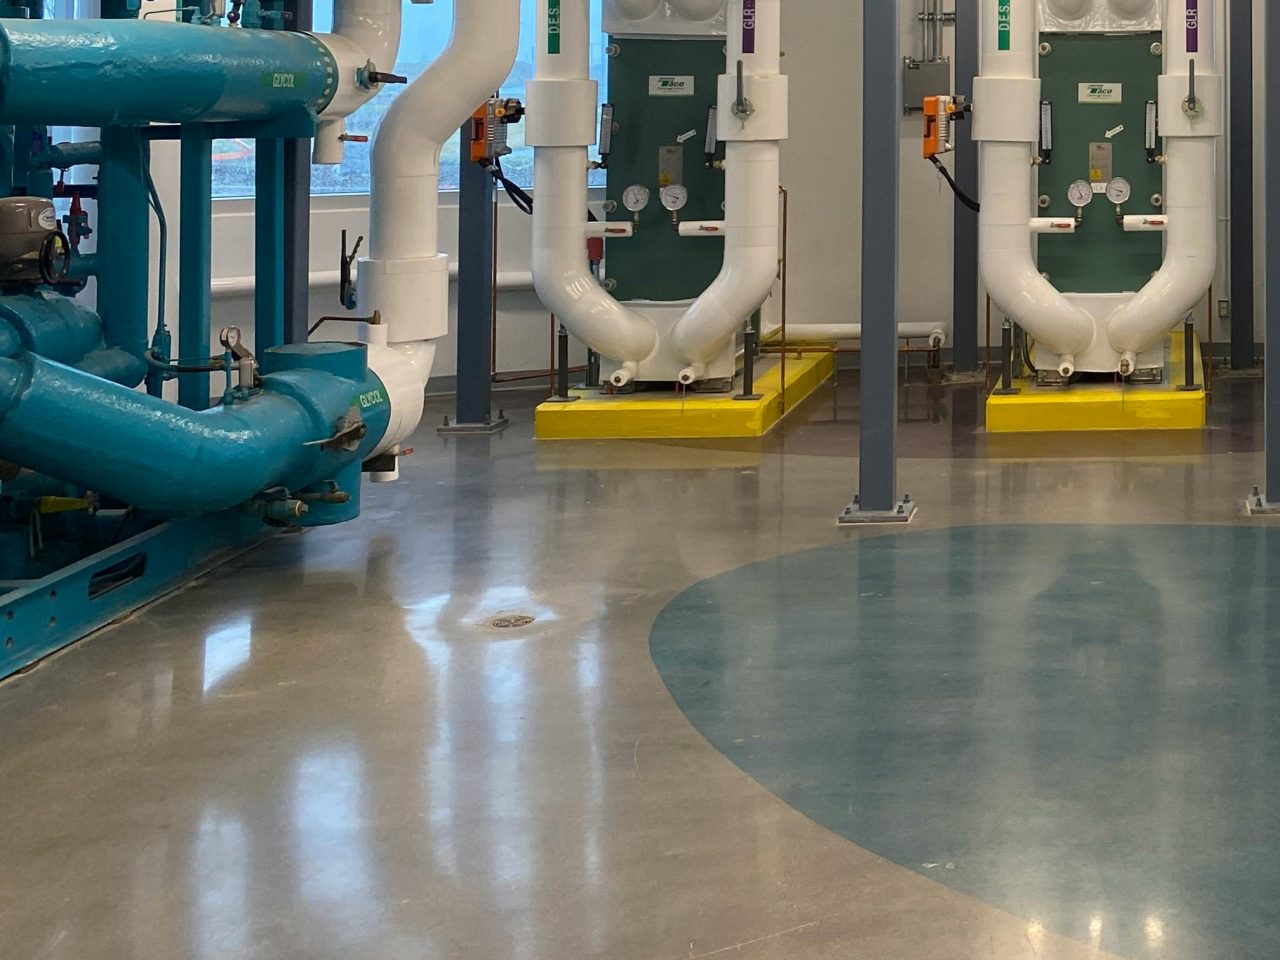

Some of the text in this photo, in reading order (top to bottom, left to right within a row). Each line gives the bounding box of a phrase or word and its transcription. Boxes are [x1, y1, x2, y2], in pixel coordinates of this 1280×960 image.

[743, 8, 755, 30] GLR
[1186, 8, 1197, 30] GLR
[272, 72, 295, 88] GLYCOL
[360, 390, 384, 408] GLYCOL
